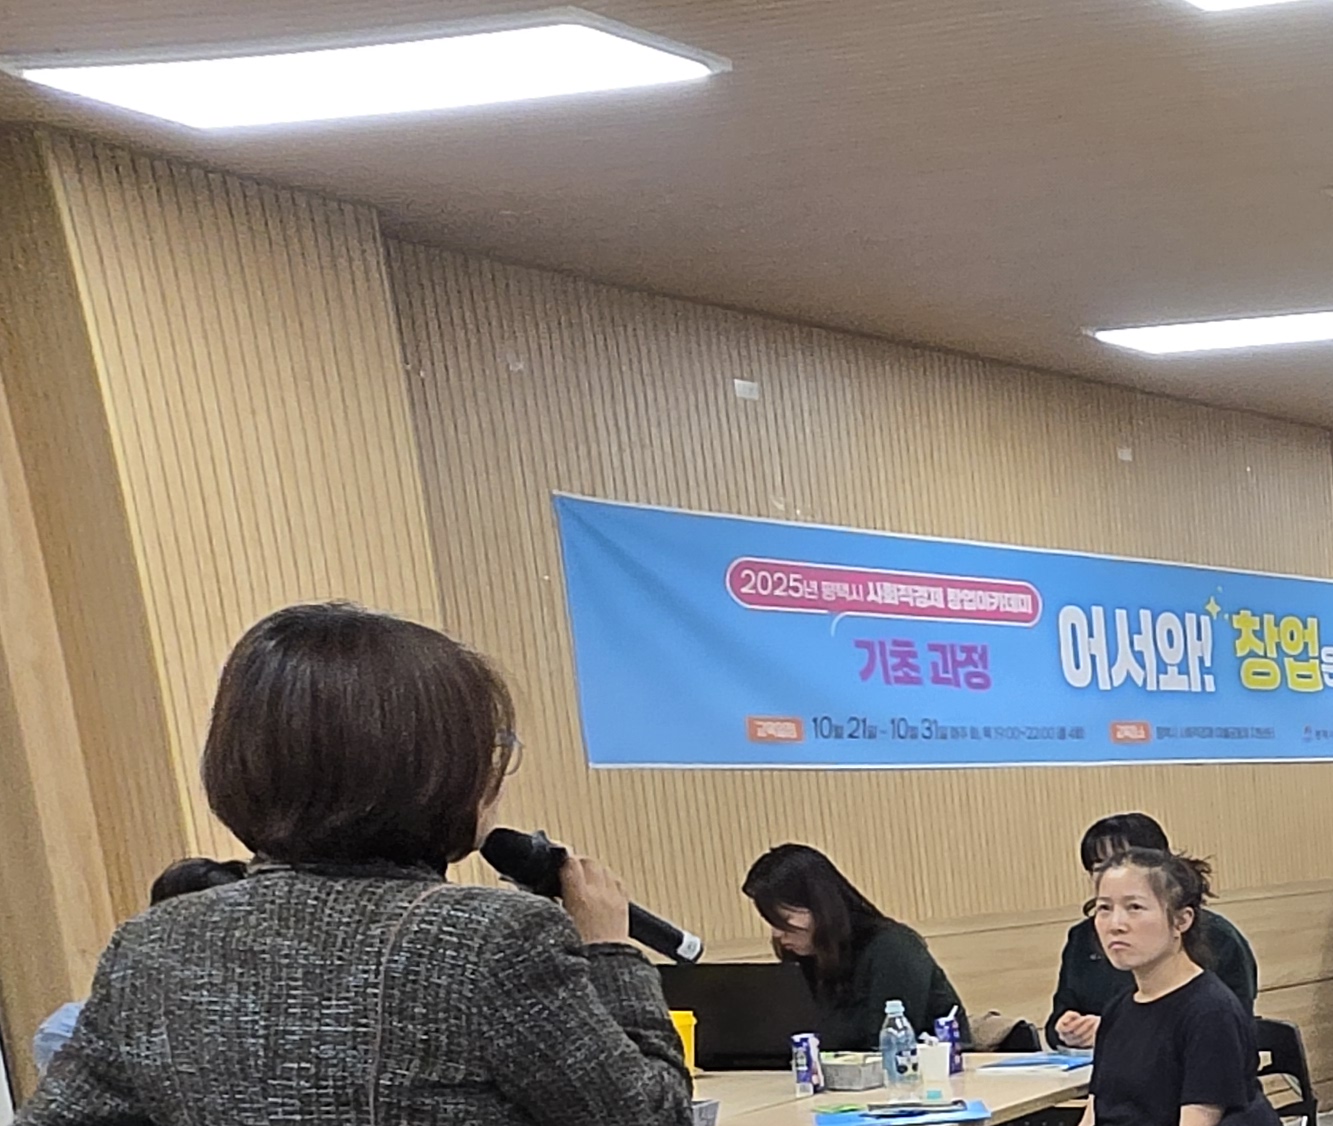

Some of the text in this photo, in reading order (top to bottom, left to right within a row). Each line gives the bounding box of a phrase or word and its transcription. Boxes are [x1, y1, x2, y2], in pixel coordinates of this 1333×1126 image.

[740, 569, 819, 600] 2025년
[853, 638, 993, 691] 기초 과정
[1058, 605, 1216, 692] 어서와!
